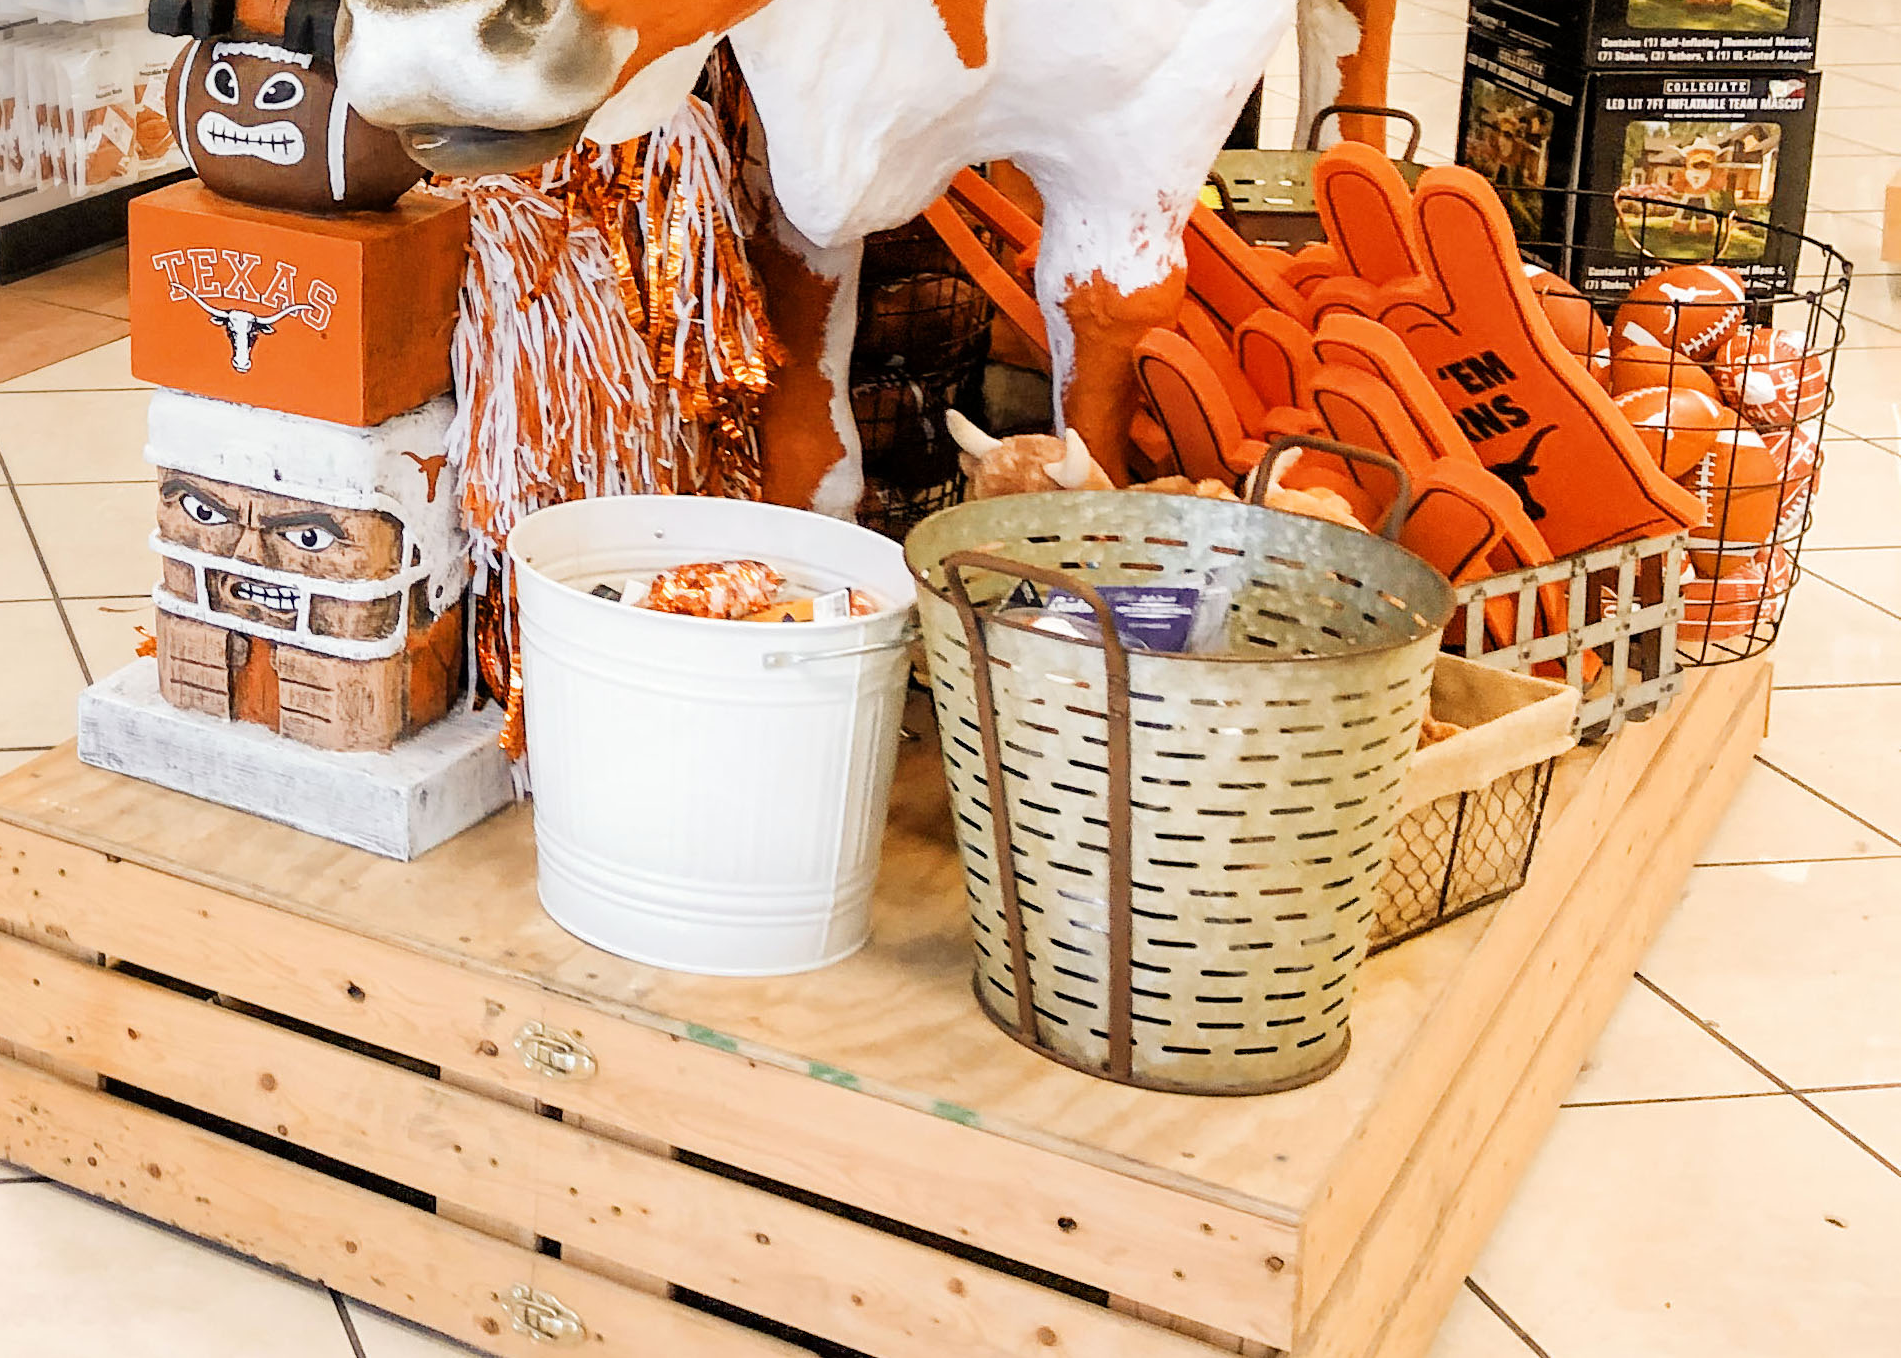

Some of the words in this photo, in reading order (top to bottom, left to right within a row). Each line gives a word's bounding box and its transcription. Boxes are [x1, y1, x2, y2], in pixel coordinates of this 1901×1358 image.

[1666, 82, 1747, 92] COLLEGIATE
[1606, 98, 1625, 110] LED
[1627, 98, 1644, 110] LIT
[1646, 98, 1665, 110] 7FT
[1667, 97, 1726, 110] INFLATABLE
[1729, 97, 1757, 109] TEAM
[1759, 97, 1805, 110] MASCOT
[152, 248, 338, 331] TEXAS
